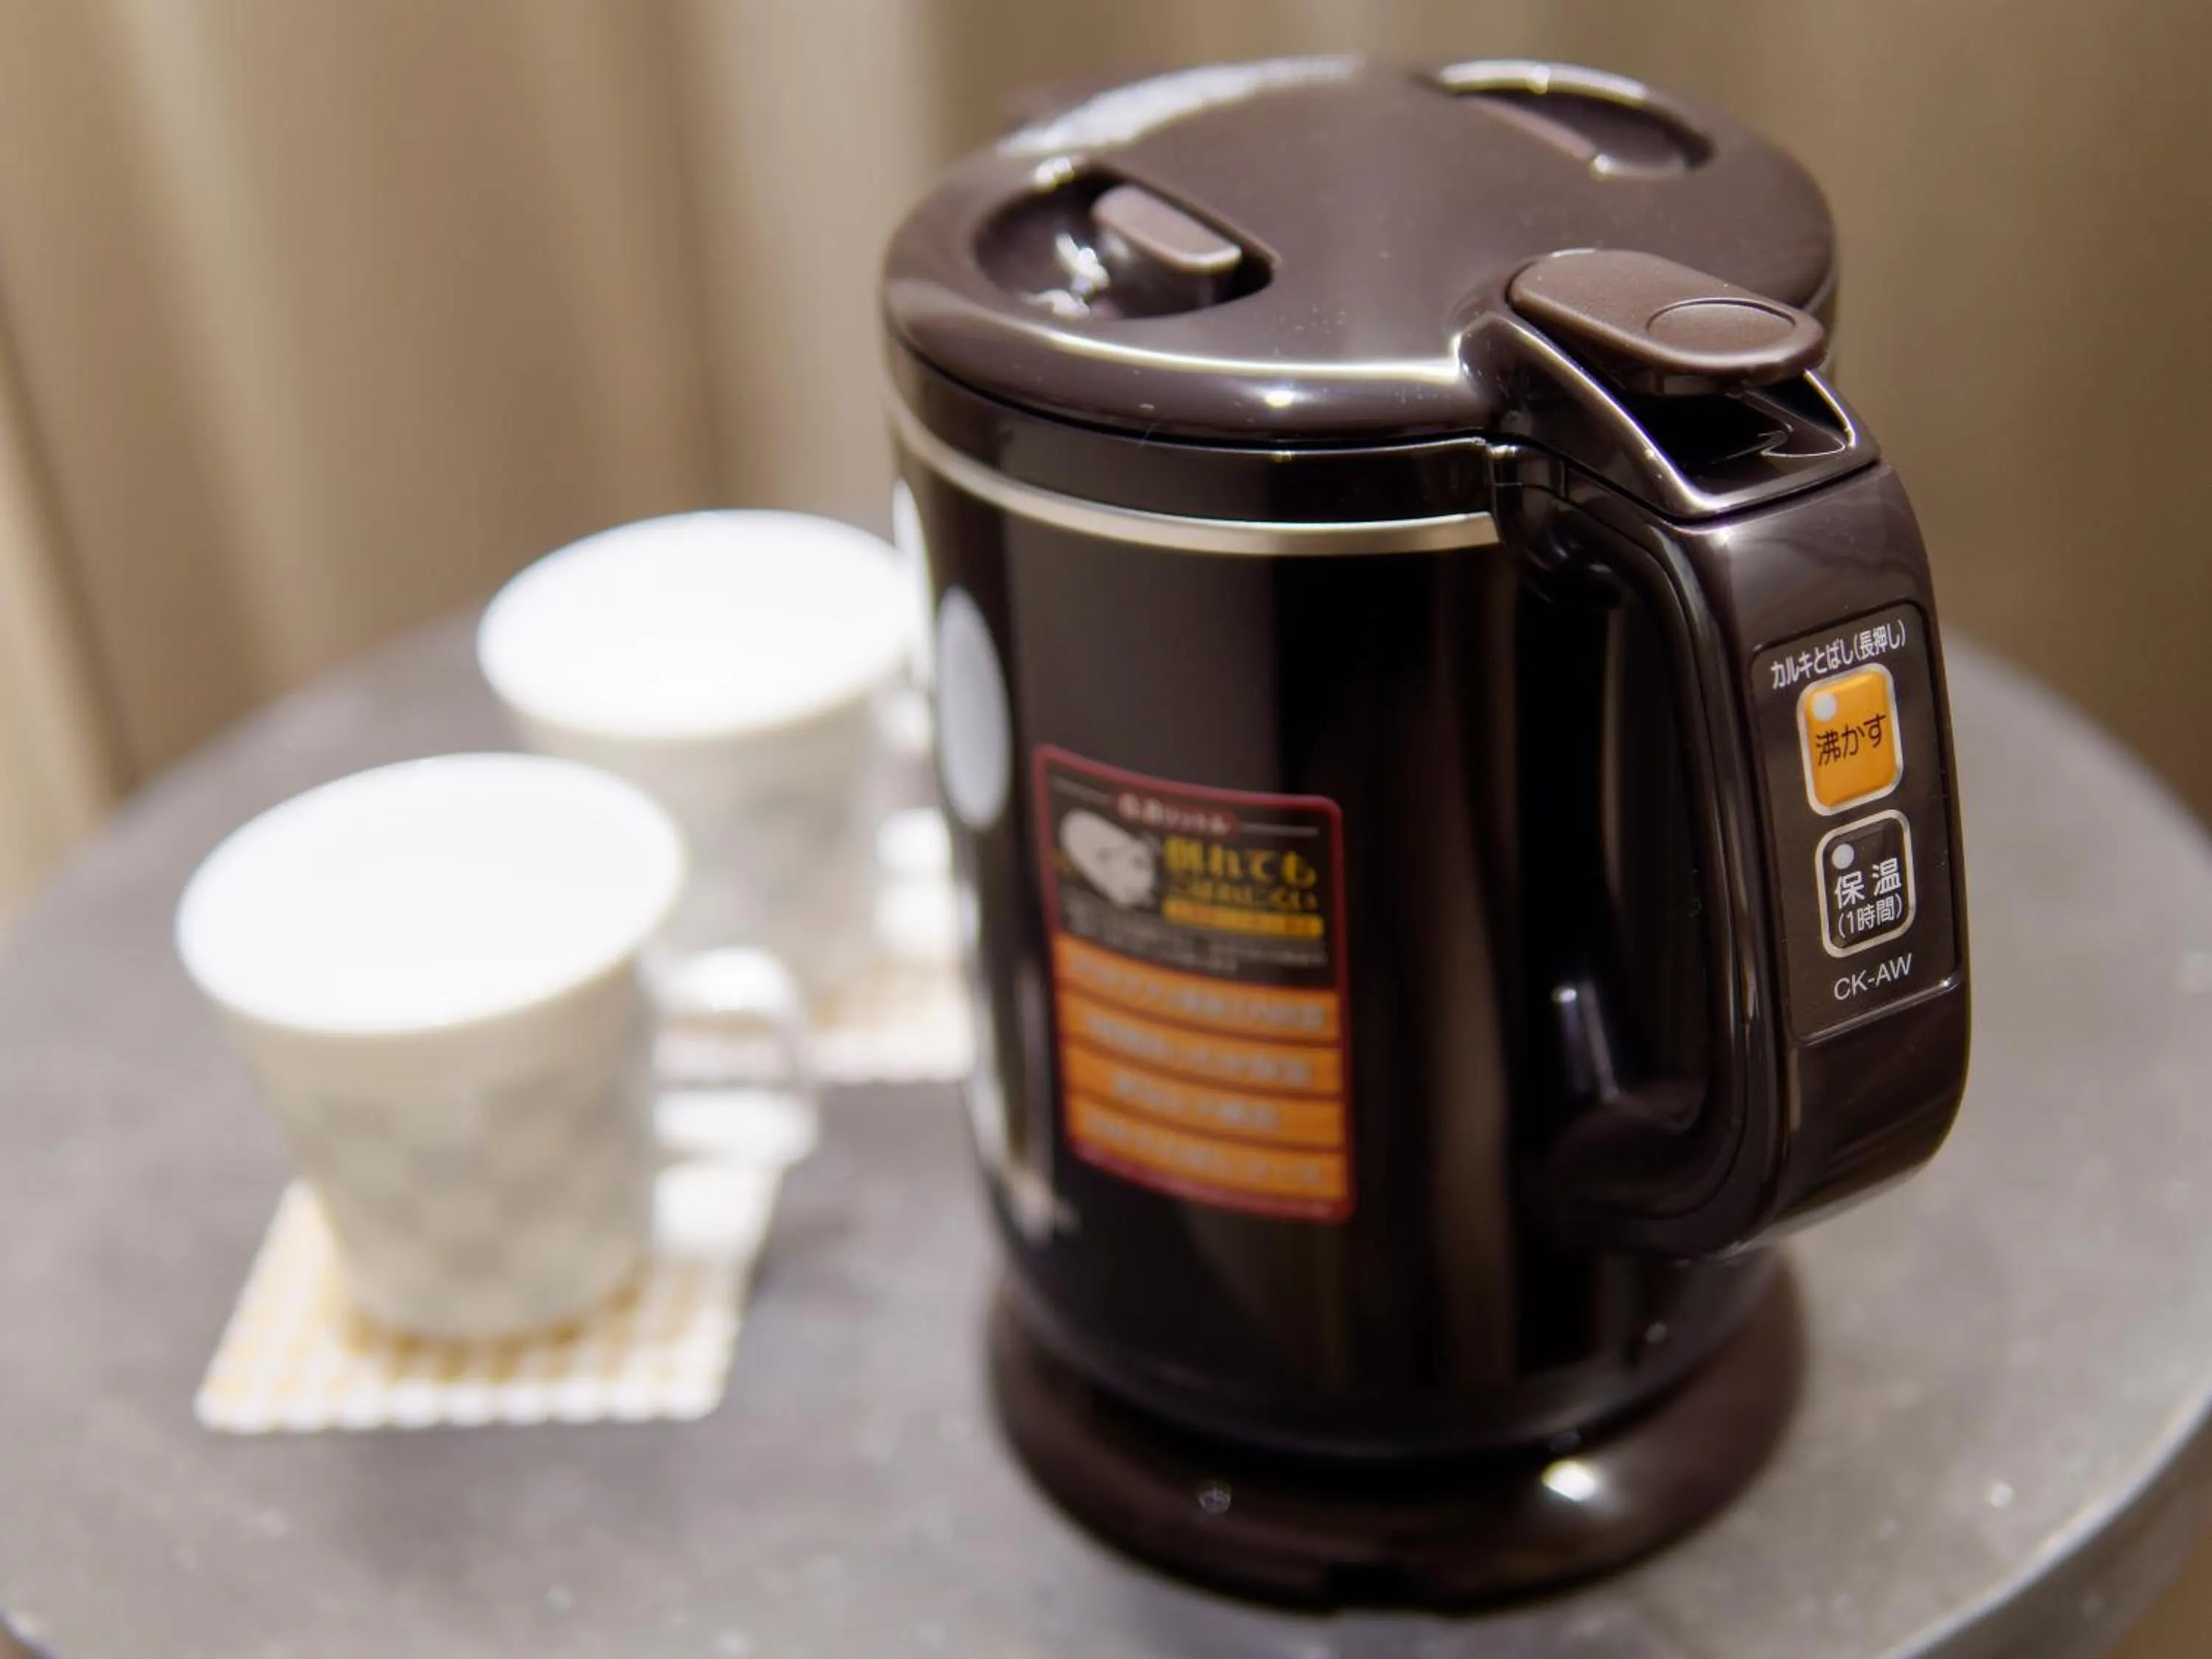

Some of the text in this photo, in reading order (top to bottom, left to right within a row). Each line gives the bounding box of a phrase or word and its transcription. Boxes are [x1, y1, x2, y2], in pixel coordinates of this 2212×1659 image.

[1771, 619, 1906, 689] カルキとばし(長押し)
[1816, 713, 1886, 766] 沸かす
[1838, 893, 1902, 939] (1時間)
[1834, 953, 1912, 1001] CK-AW
